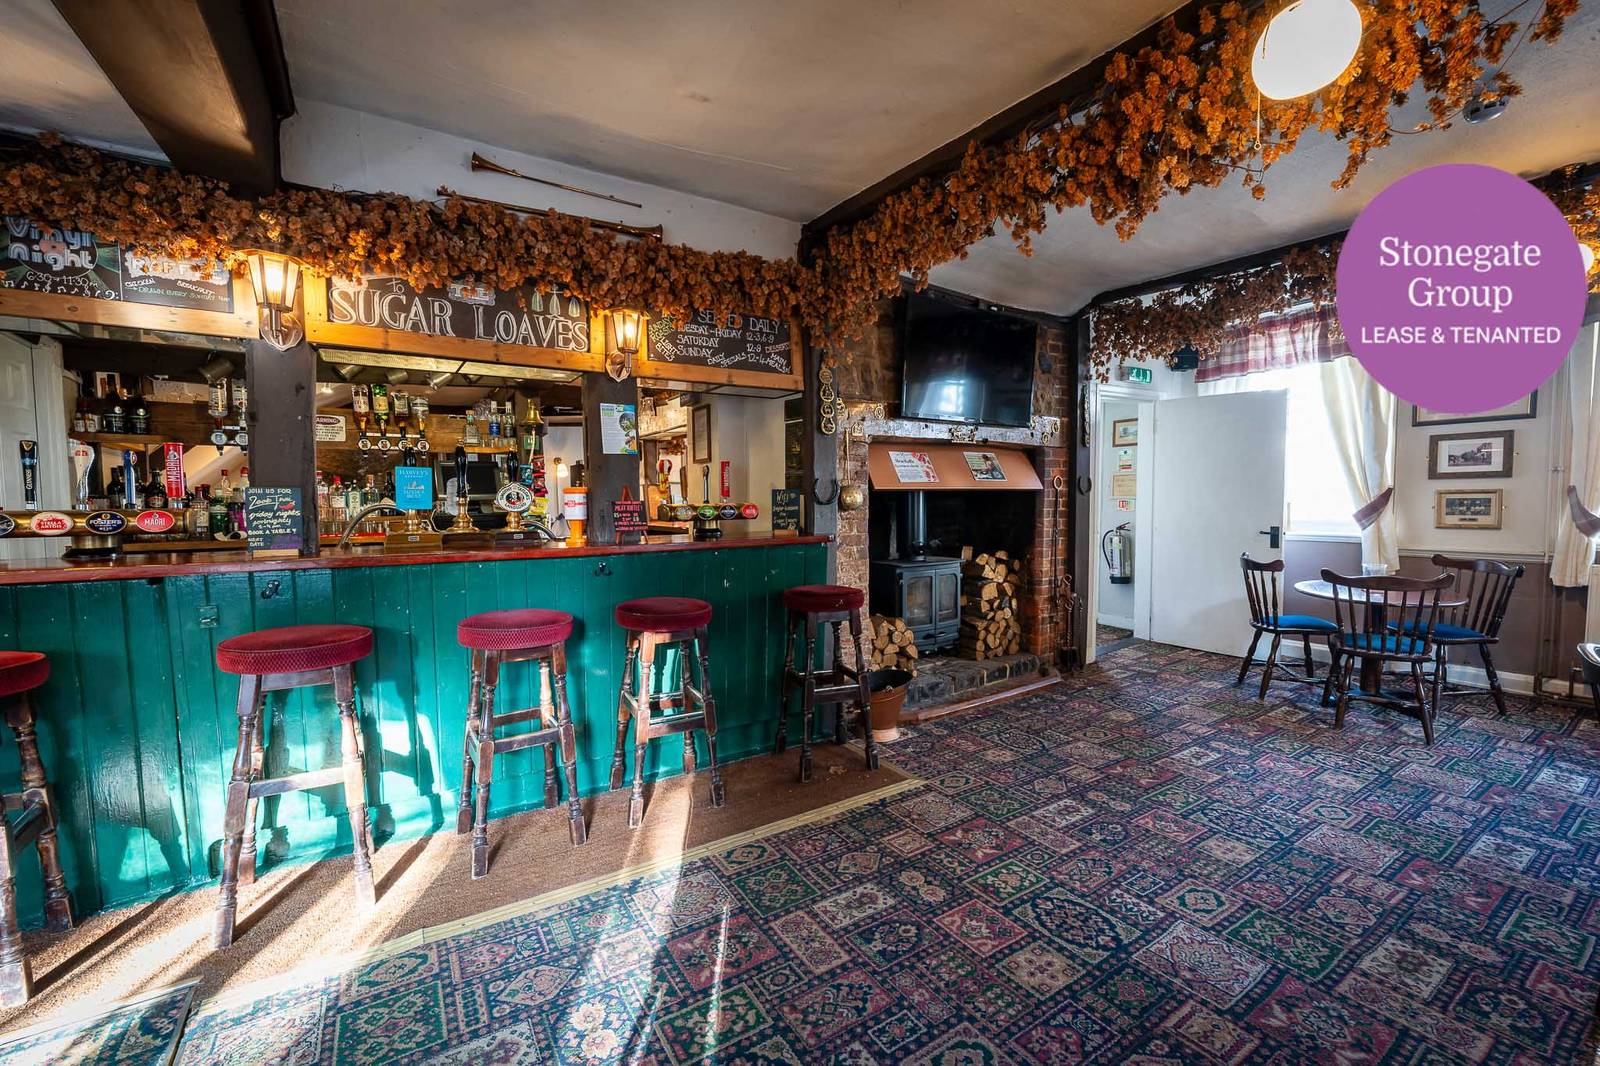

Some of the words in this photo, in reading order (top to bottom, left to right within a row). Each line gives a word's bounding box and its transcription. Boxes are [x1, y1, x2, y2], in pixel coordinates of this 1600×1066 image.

[5, 216, 92, 249] Vinyl
[386, 279, 405, 294] to
[329, 286, 455, 337] SUGAR
[473, 304, 591, 352] LOAVES
[749, 317, 780, 334] DAILY
[676, 334, 719, 348] SATURDAY
[715, 328, 743, 339] FRIDAY
[677, 345, 712, 357] SUNDAY
